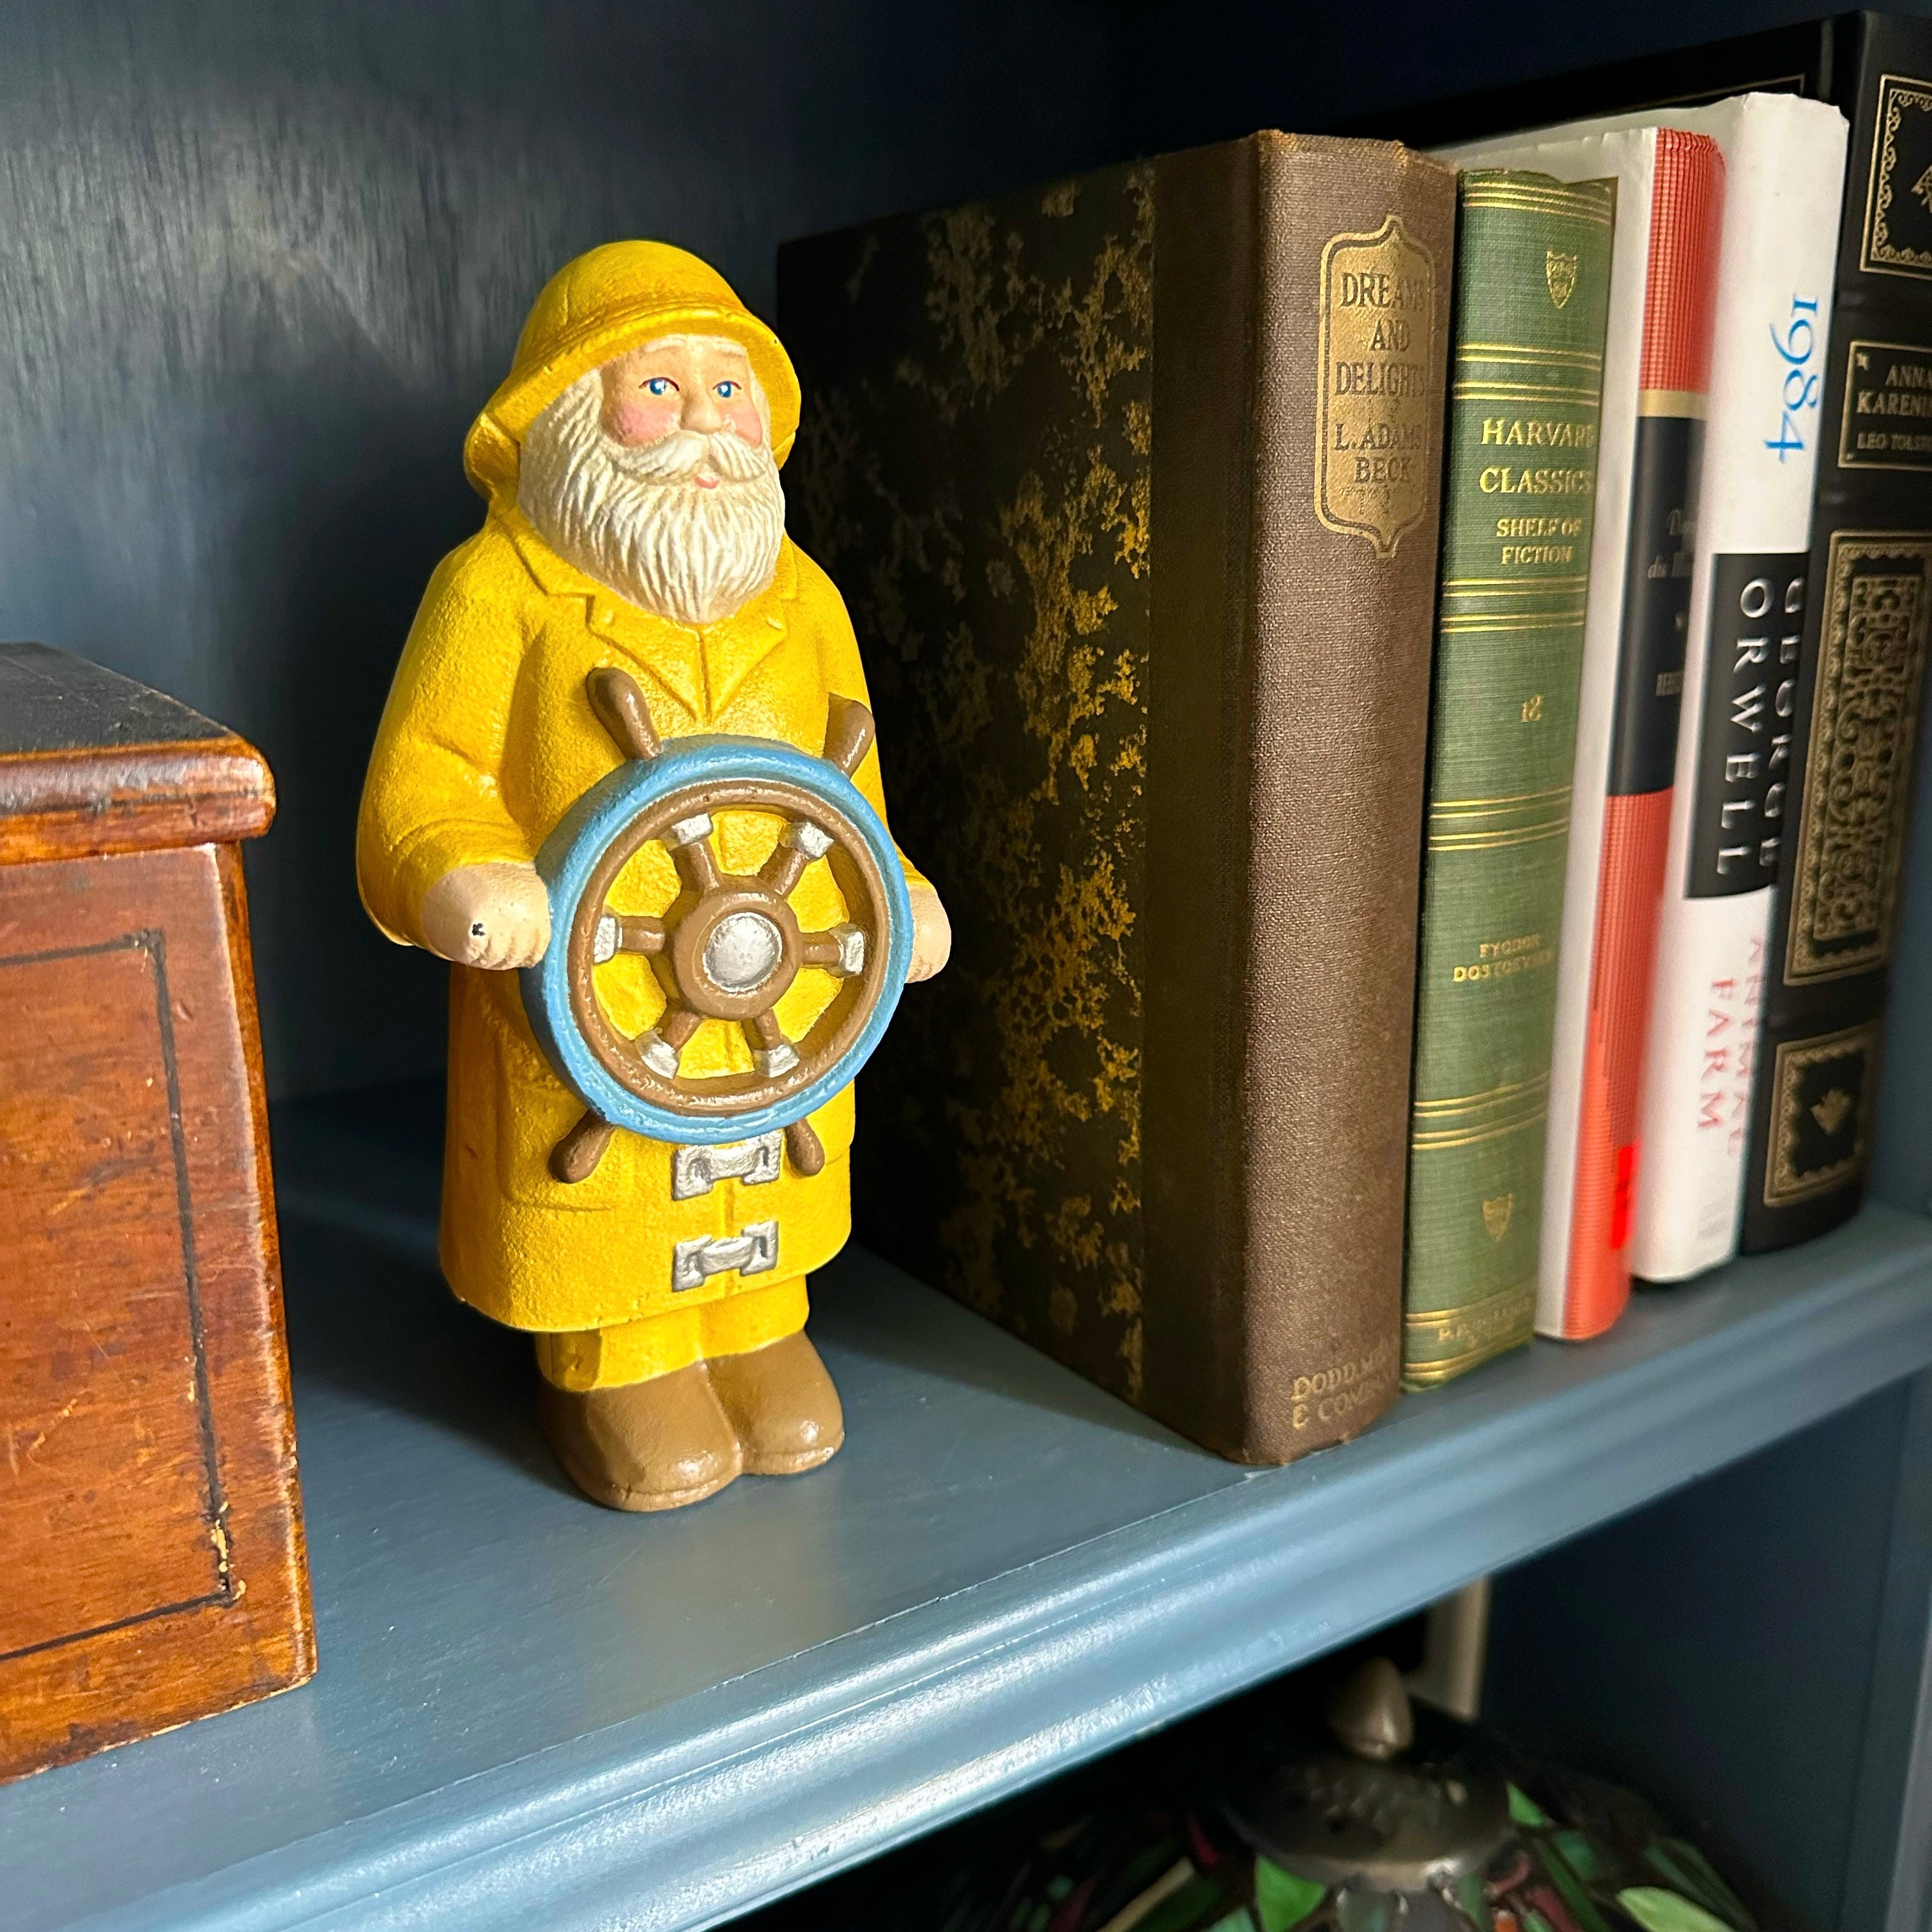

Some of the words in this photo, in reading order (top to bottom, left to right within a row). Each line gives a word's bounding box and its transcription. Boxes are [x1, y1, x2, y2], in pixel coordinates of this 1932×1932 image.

[1368, 318, 1409, 351] AND
[1764, 293, 1818, 464] 1984
[1481, 417, 1595, 448] HARVARD
[1857, 431, 1889, 449] LEO
[1354, 456, 1411, 484] BECK
[1479, 465, 1593, 494] CLASSICS
[1496, 516, 1558, 537] SHELF
[1561, 517, 1583, 537] OF
[1501, 546, 1574, 565] FICTION
[1717, 577, 1775, 875] ORWELL
[1698, 975, 1737, 1130] FARM
